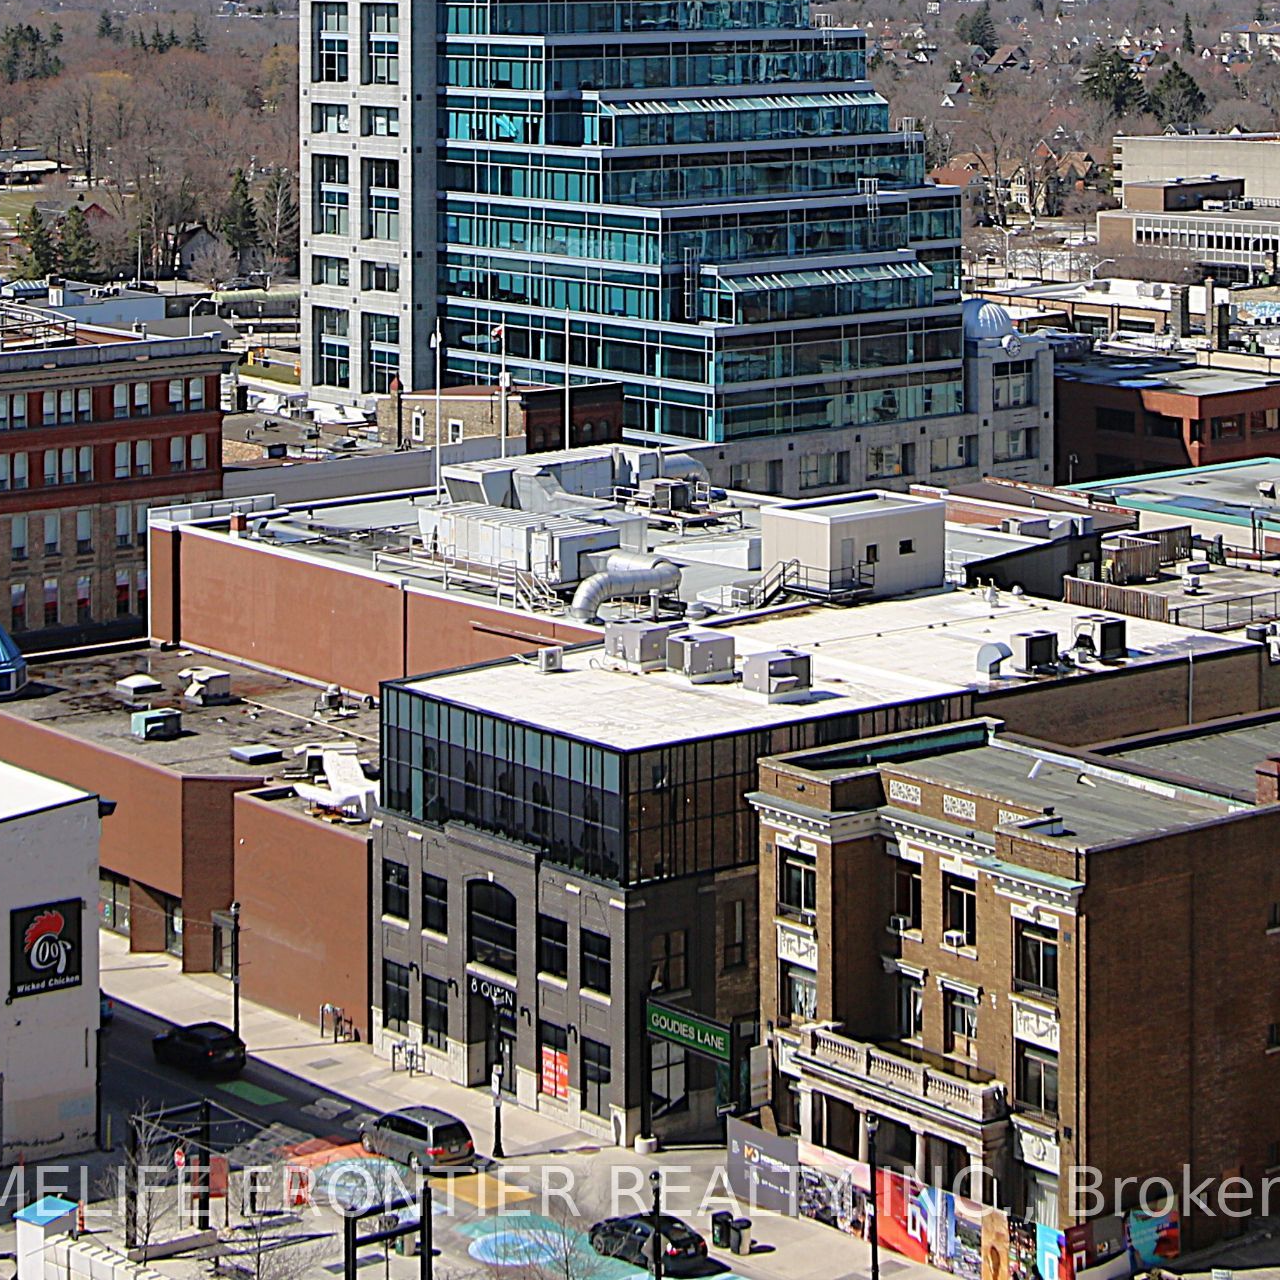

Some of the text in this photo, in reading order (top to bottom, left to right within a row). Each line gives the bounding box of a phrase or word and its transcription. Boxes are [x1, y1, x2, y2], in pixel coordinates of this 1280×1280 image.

[16, 974, 80, 993] Wicked Chicken
[471, 978, 478, 993] 8
[651, 1013, 725, 1051] GOUDIES LANE
